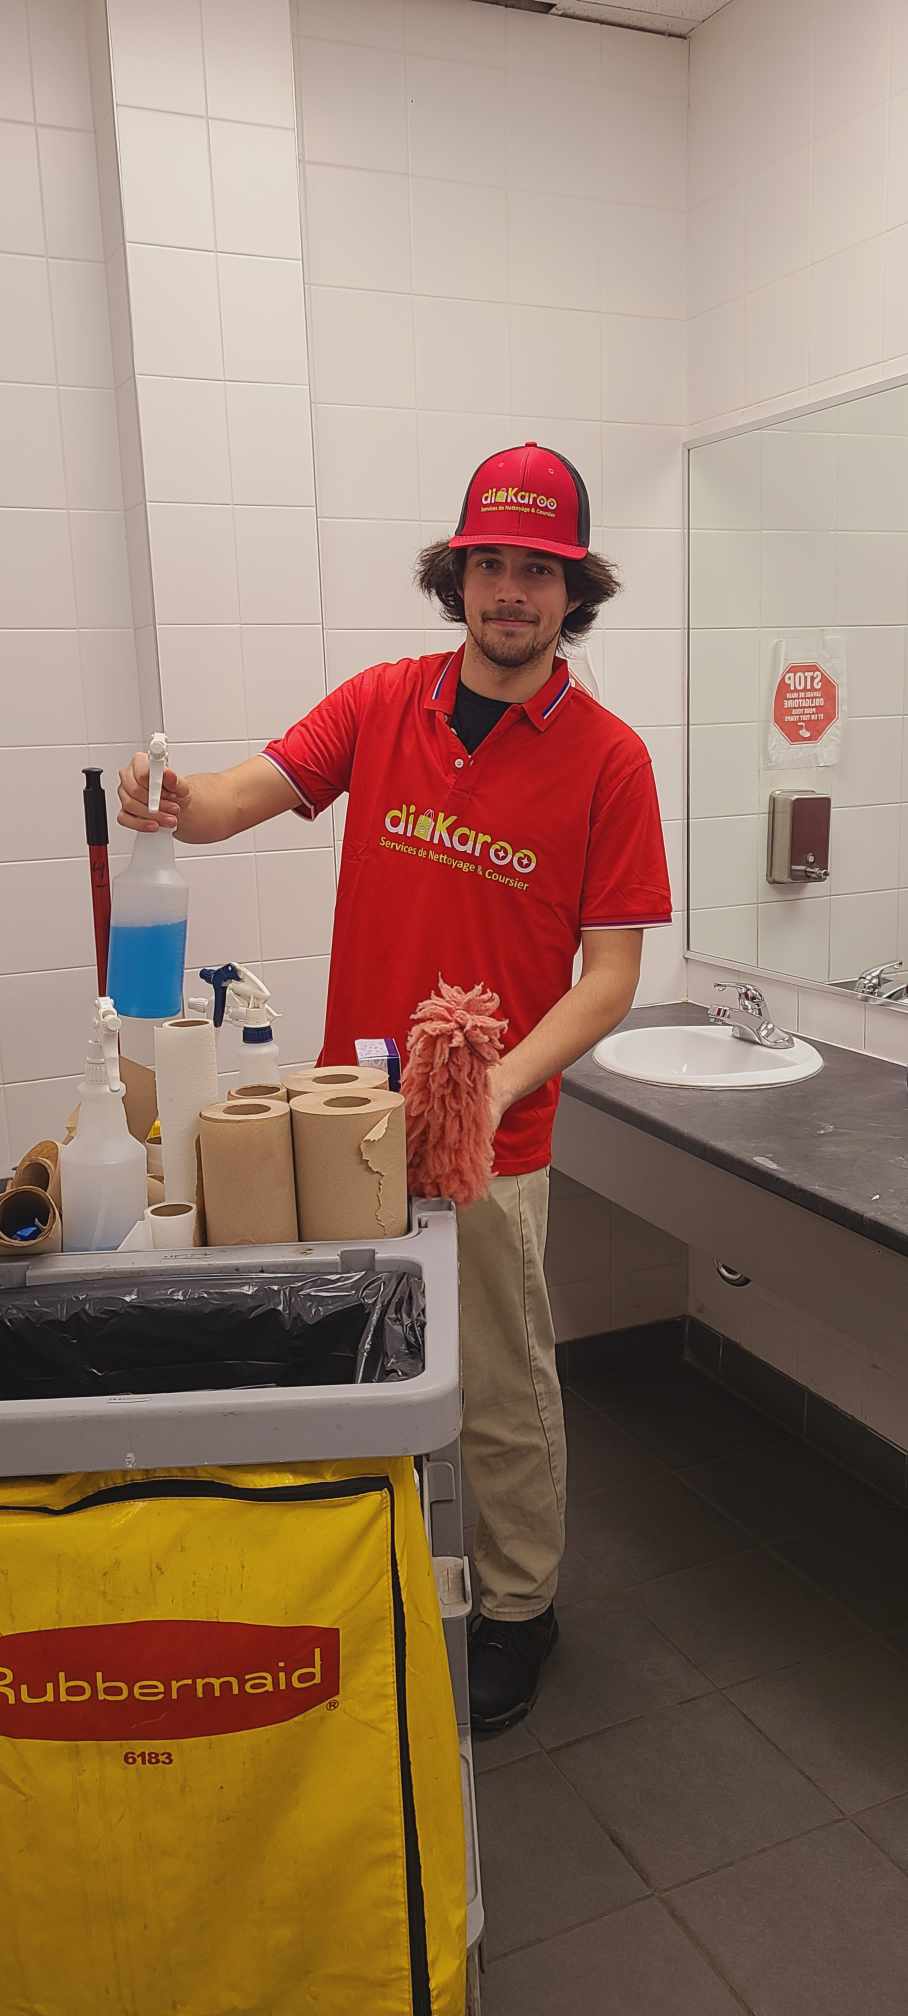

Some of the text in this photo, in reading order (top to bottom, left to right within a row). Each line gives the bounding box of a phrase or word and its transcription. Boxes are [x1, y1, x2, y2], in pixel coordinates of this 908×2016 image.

[379, 836, 529, 891] Services de Nettoyage & Coursier
[123, 1751, 173, 1766] 6183
